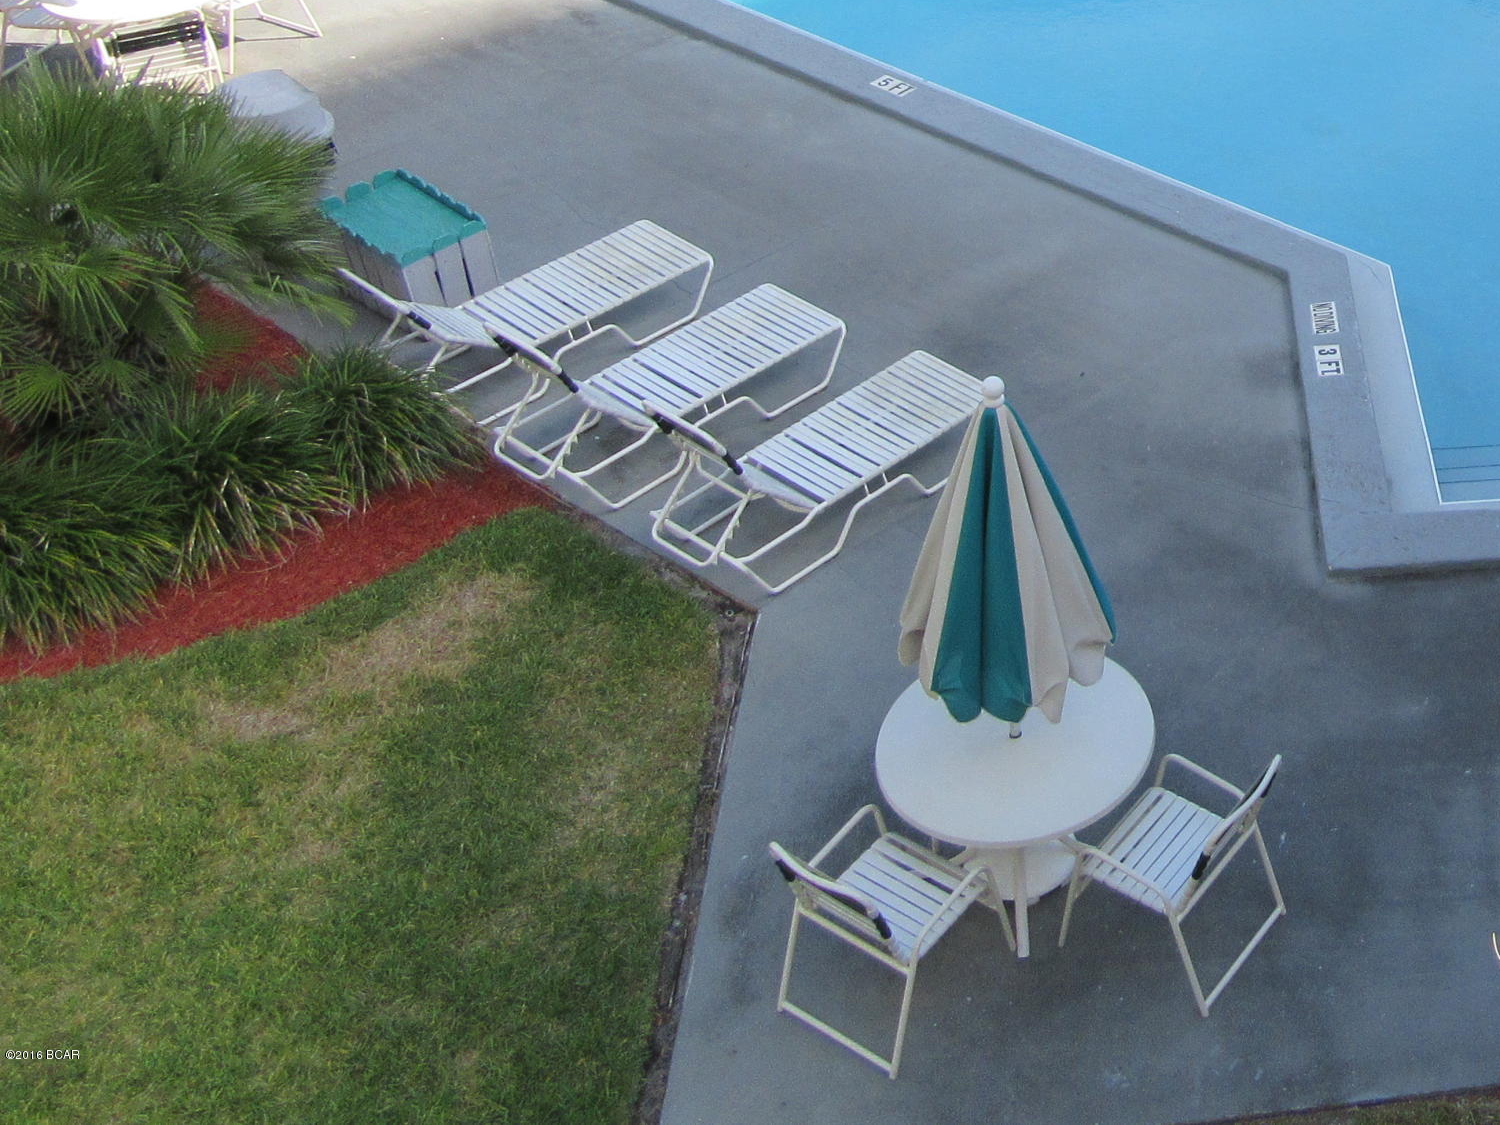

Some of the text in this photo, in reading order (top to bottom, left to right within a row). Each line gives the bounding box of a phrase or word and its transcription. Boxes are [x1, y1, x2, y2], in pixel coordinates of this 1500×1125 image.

[877, 77, 913, 95] 5 FT
[1312, 303, 1337, 334] NO DIVING
[1319, 360, 1341, 375] FT
